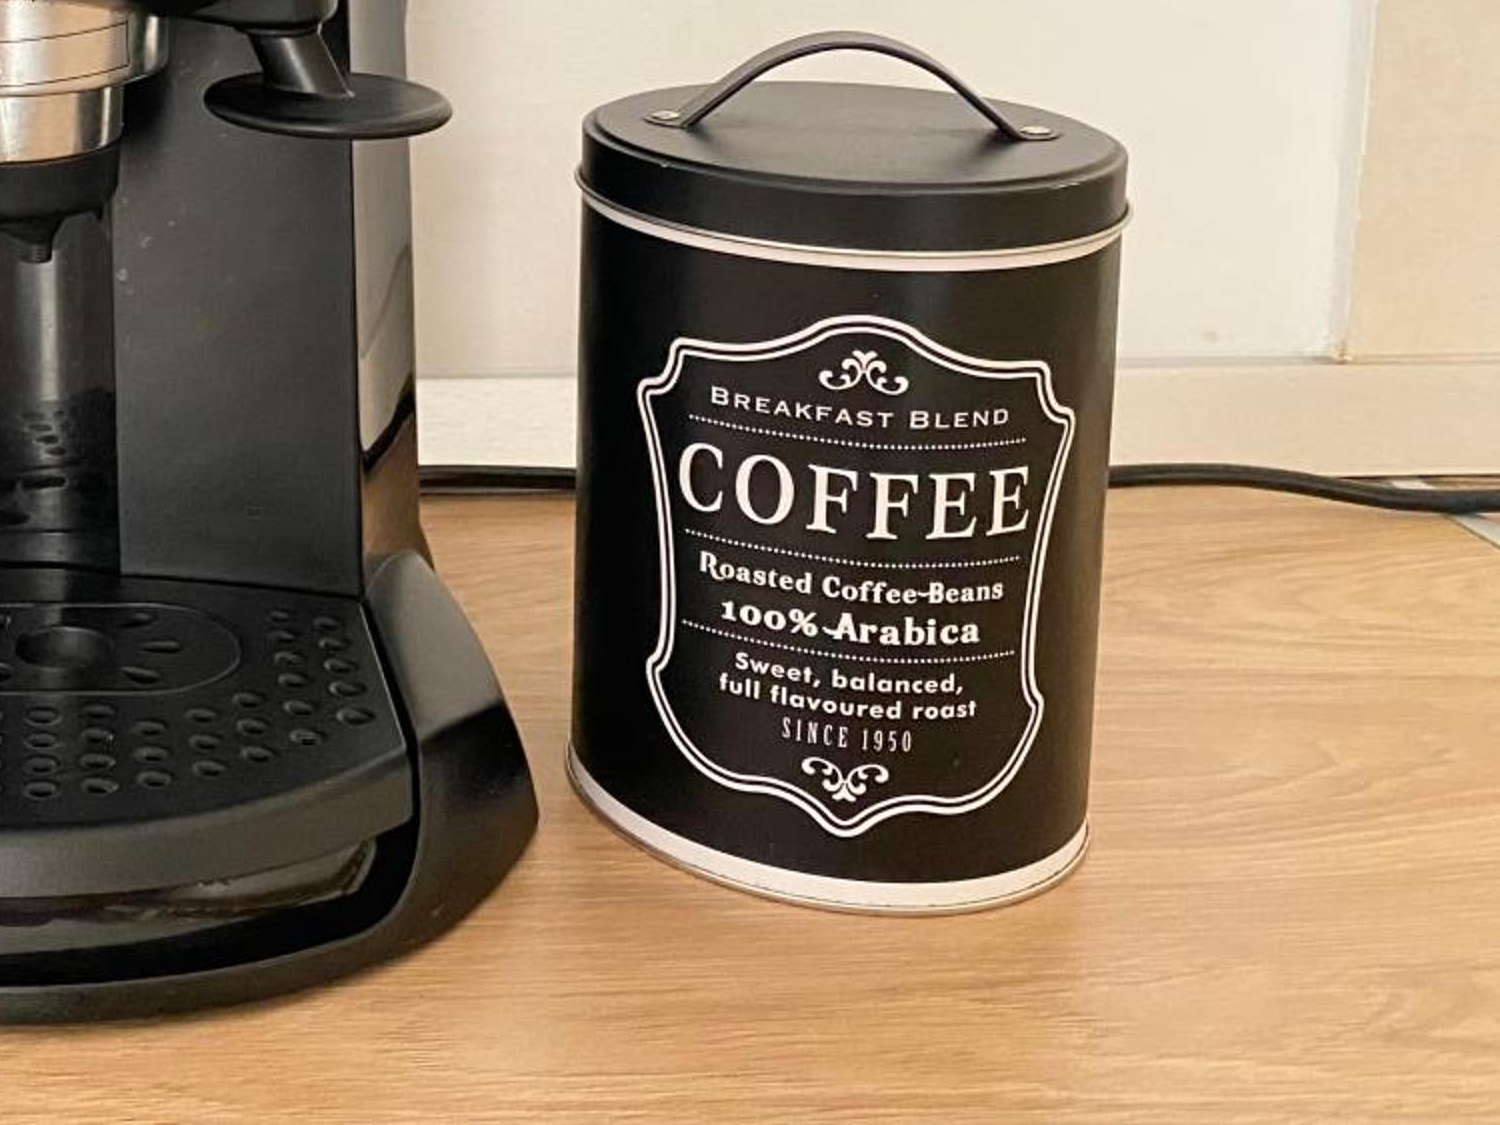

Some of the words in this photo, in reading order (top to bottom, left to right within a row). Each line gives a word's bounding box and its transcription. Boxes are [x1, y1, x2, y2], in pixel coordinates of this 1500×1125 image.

[677, 441, 1031, 542] COFFEE
[699, 550, 813, 595] Roasted
[719, 672, 761, 700] full
[769, 684, 902, 720] flavoured
[911, 699, 978, 720] roast
[734, 651, 821, 688] Sweet,
[831, 668, 963, 696] balanced,
[781, 716, 850, 749] SINCE
[861, 729, 914, 754] 1950
